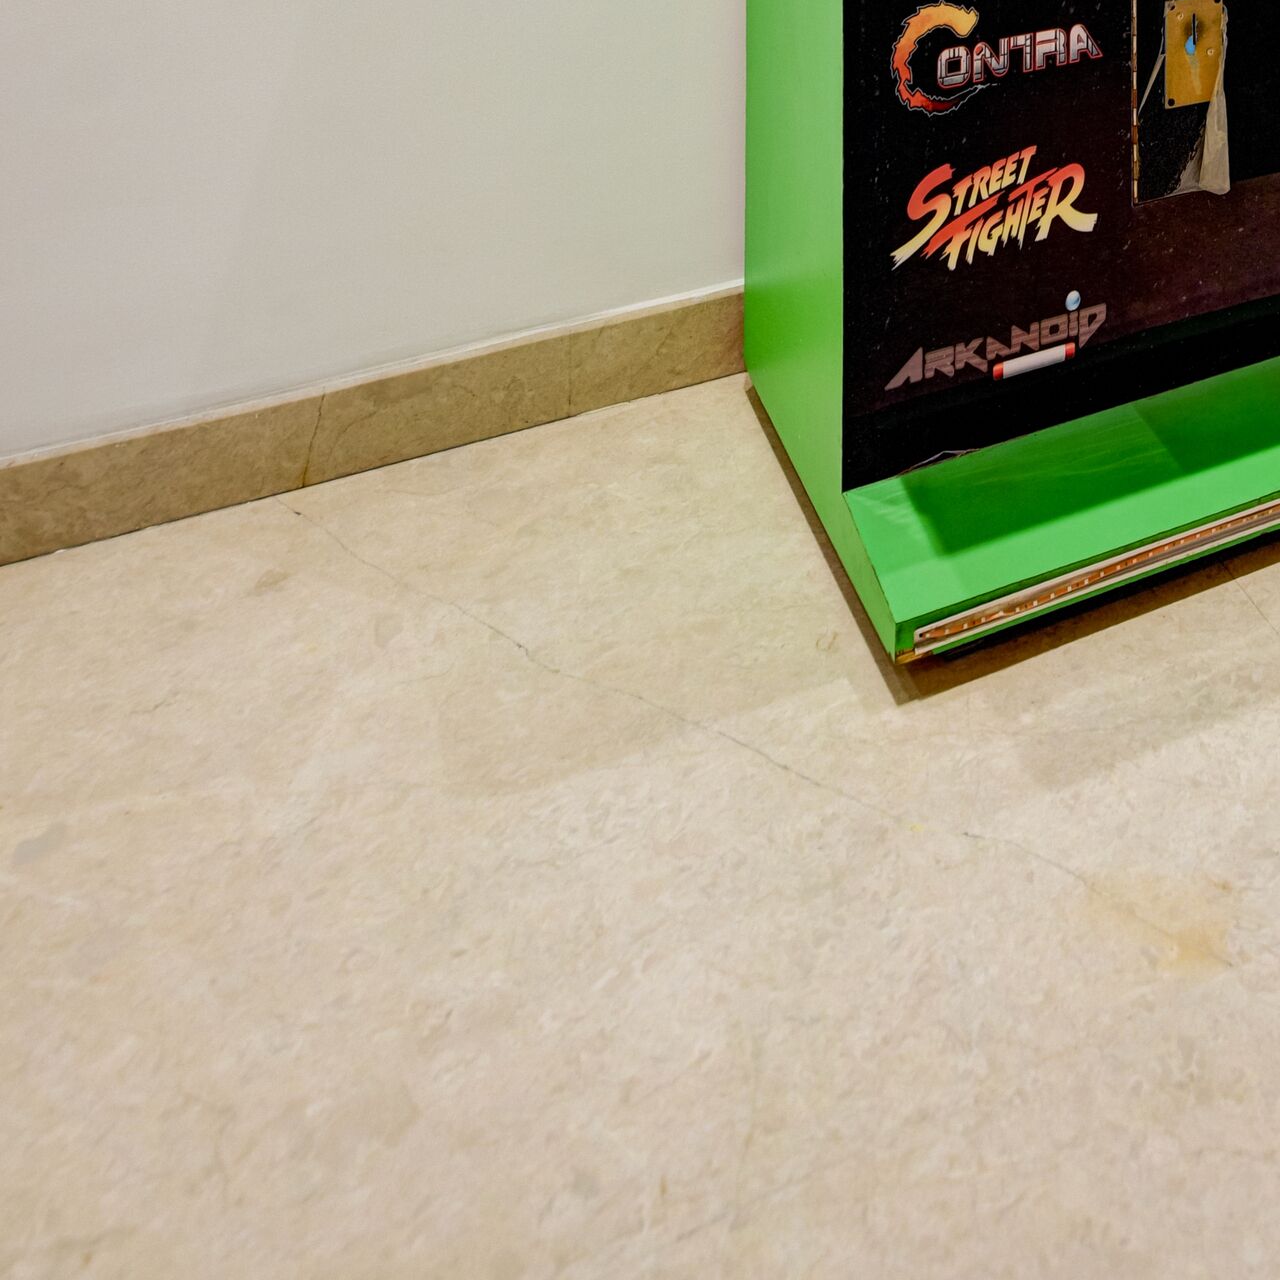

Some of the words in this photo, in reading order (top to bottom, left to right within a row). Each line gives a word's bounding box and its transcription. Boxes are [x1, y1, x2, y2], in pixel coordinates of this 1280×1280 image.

[890, 0, 1102, 116] CONTRA
[890, 145, 1037, 270] STREET
[921, 163, 1097, 271] FIGHTER
[885, 292, 1106, 390] ARKANOID
